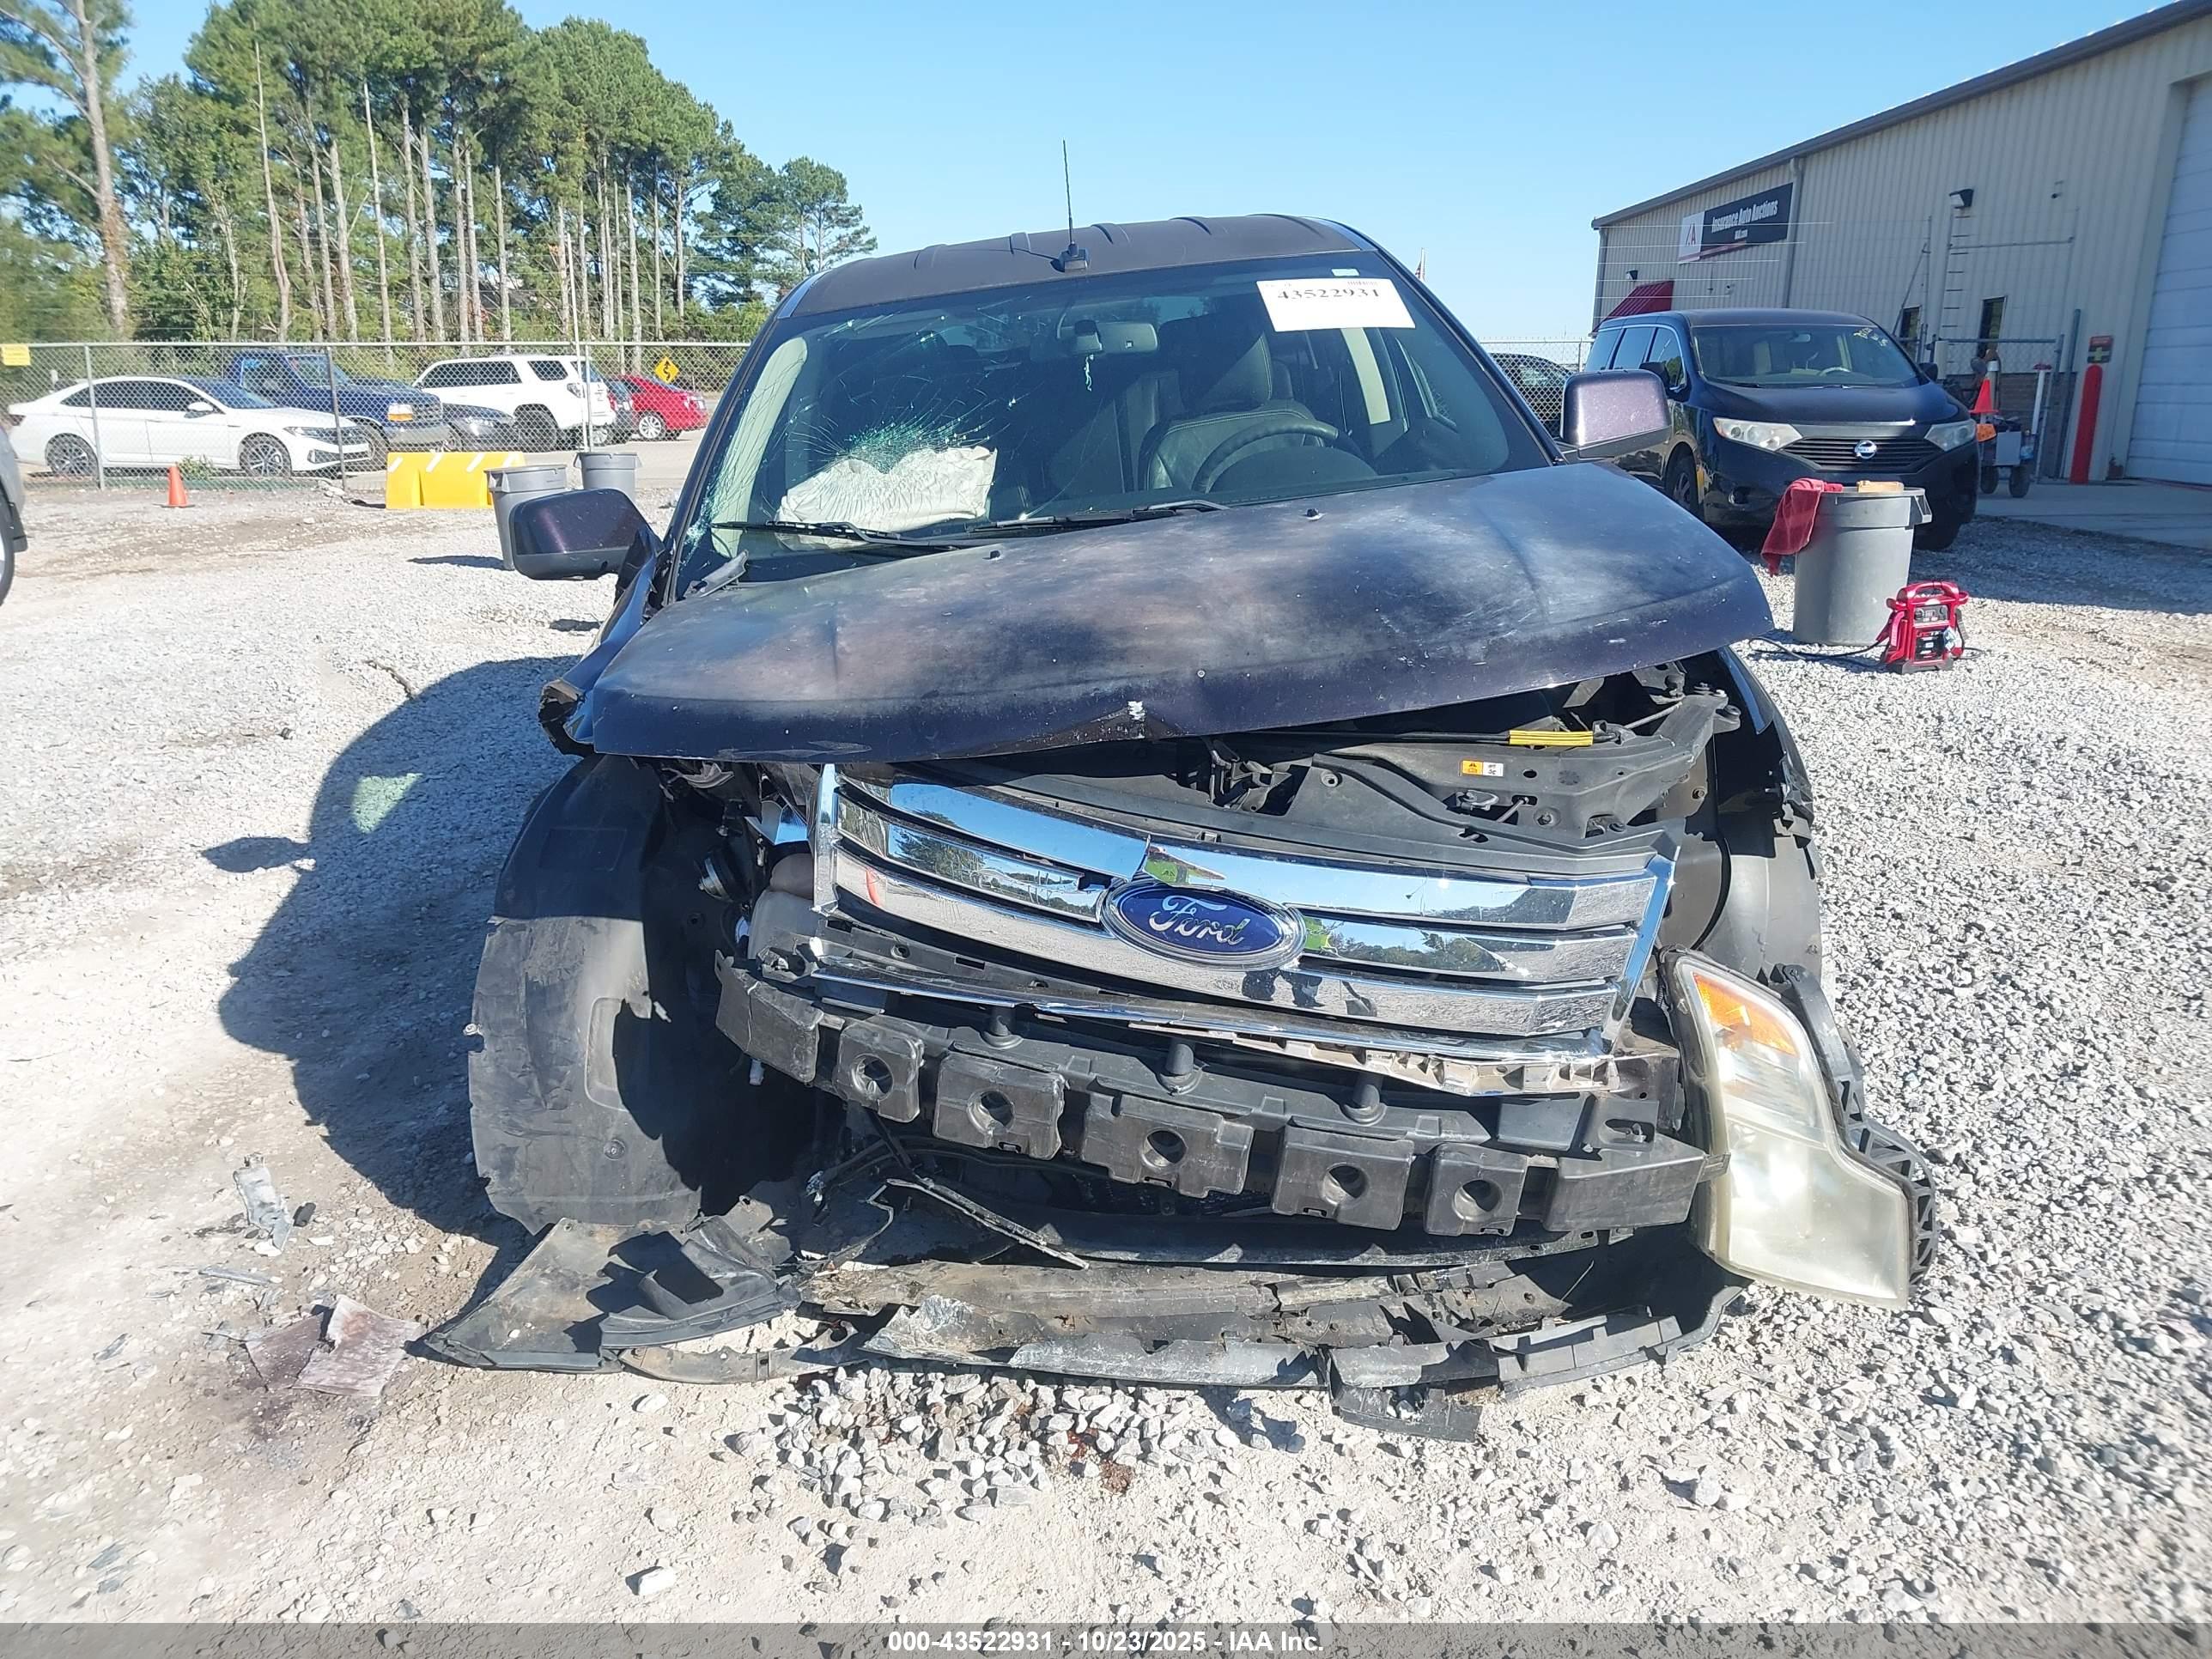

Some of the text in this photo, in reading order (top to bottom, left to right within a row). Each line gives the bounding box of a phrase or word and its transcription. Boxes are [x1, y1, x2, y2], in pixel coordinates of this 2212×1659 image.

[1738, 207, 1752, 225] Auto
[1278, 289, 1379, 299] 43522931
[1149, 895, 1250, 945] Ford
